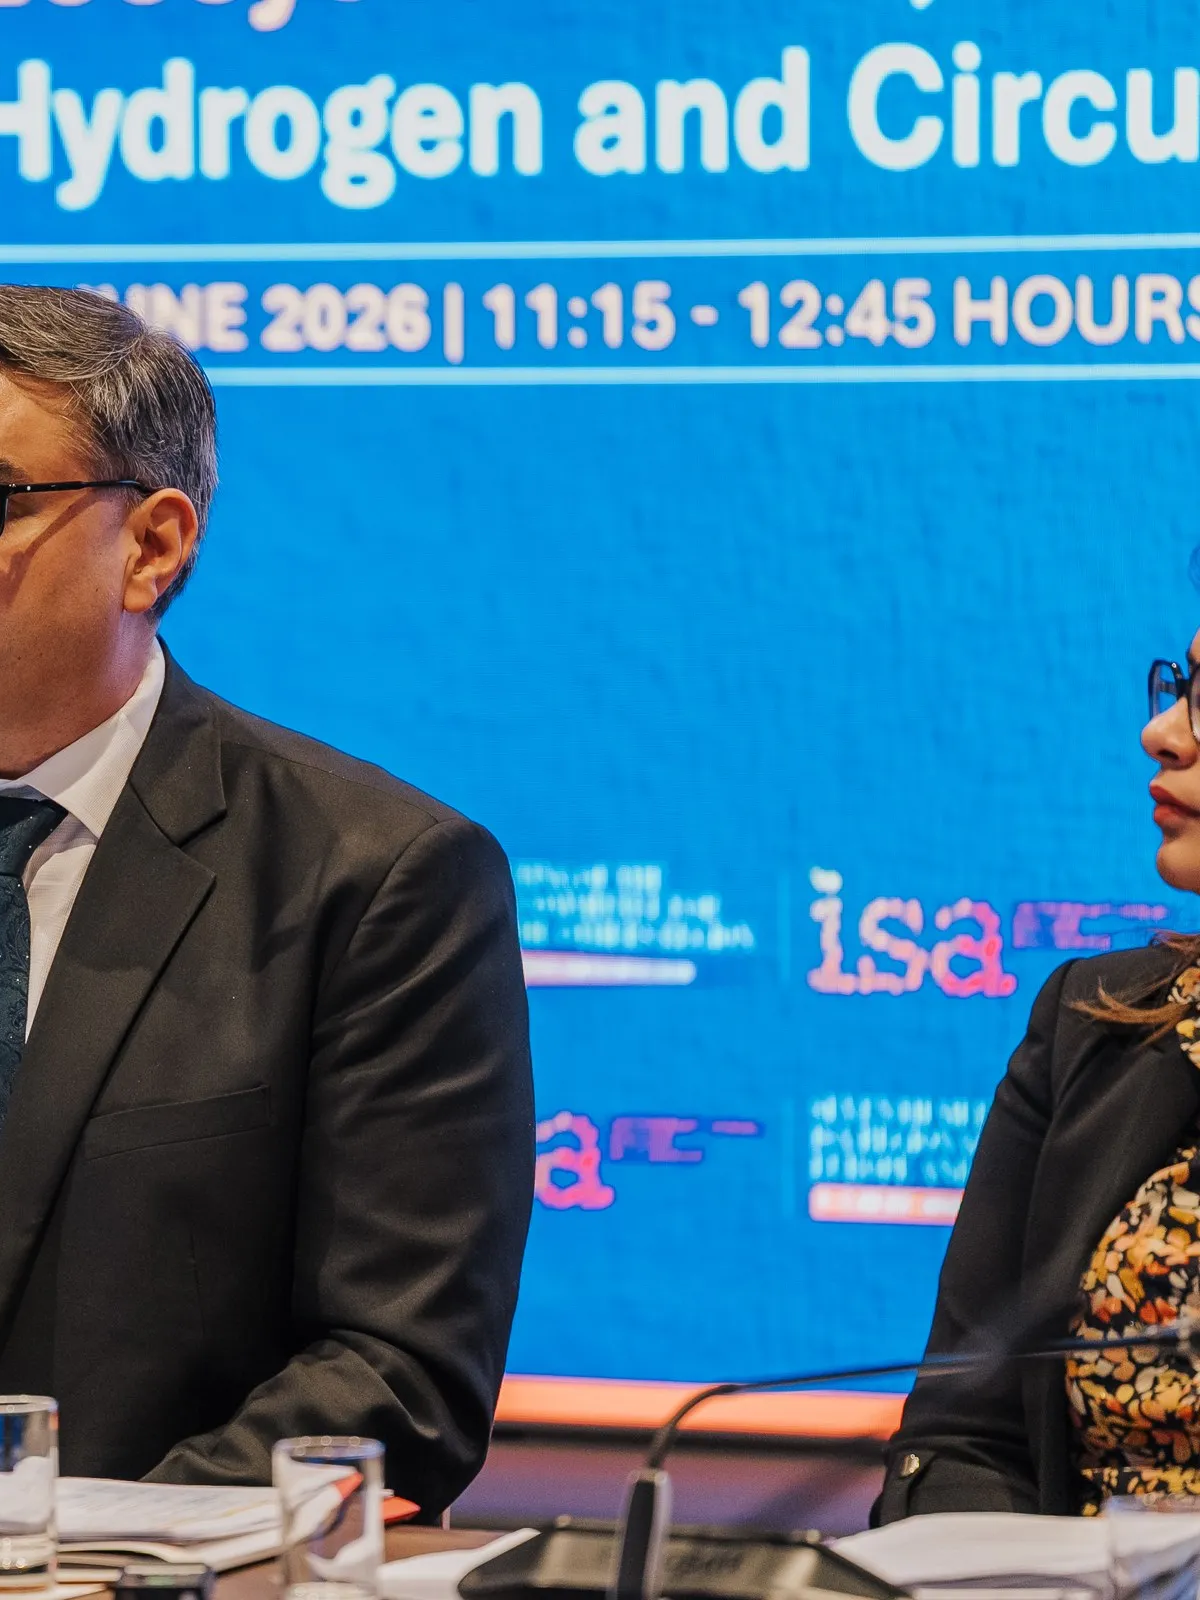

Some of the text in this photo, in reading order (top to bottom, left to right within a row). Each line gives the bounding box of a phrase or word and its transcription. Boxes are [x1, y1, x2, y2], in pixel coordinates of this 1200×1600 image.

[574, 45, 811, 176] and
[847, 40, 1200, 172] Circu
[260, 282, 432, 352] 2026
[483, 280, 676, 352] 11:15
[738, 278, 937, 349] 12:45
[808, 867, 1017, 997] isa
